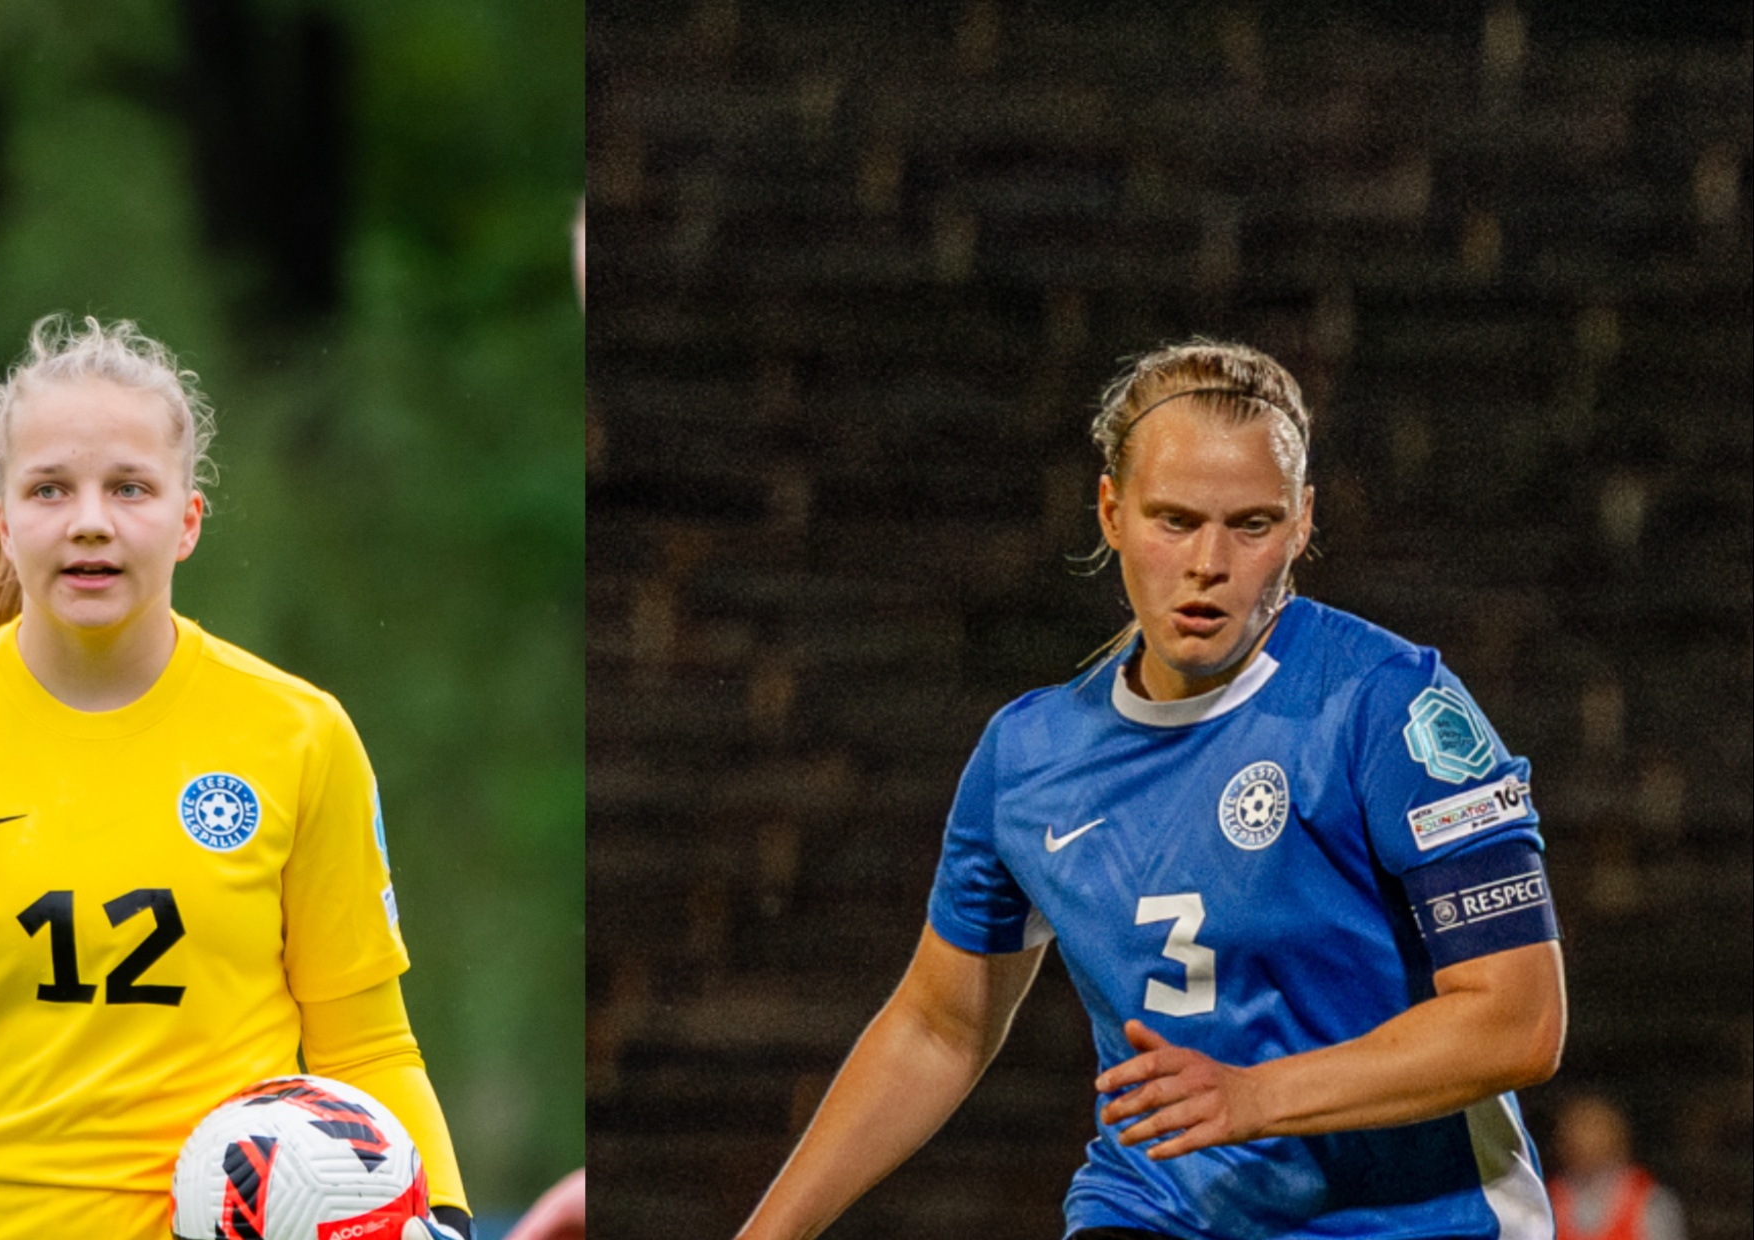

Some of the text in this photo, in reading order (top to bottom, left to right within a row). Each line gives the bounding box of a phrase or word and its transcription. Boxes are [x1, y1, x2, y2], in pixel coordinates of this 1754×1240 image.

[197, 777, 243, 793] EESTI
[183, 797, 256, 847] JALGPALLI LIIT
[1462, 877, 1544, 916] RESPECT
[16, 889, 187, 1007] 12
[1134, 892, 1216, 1017] 3
